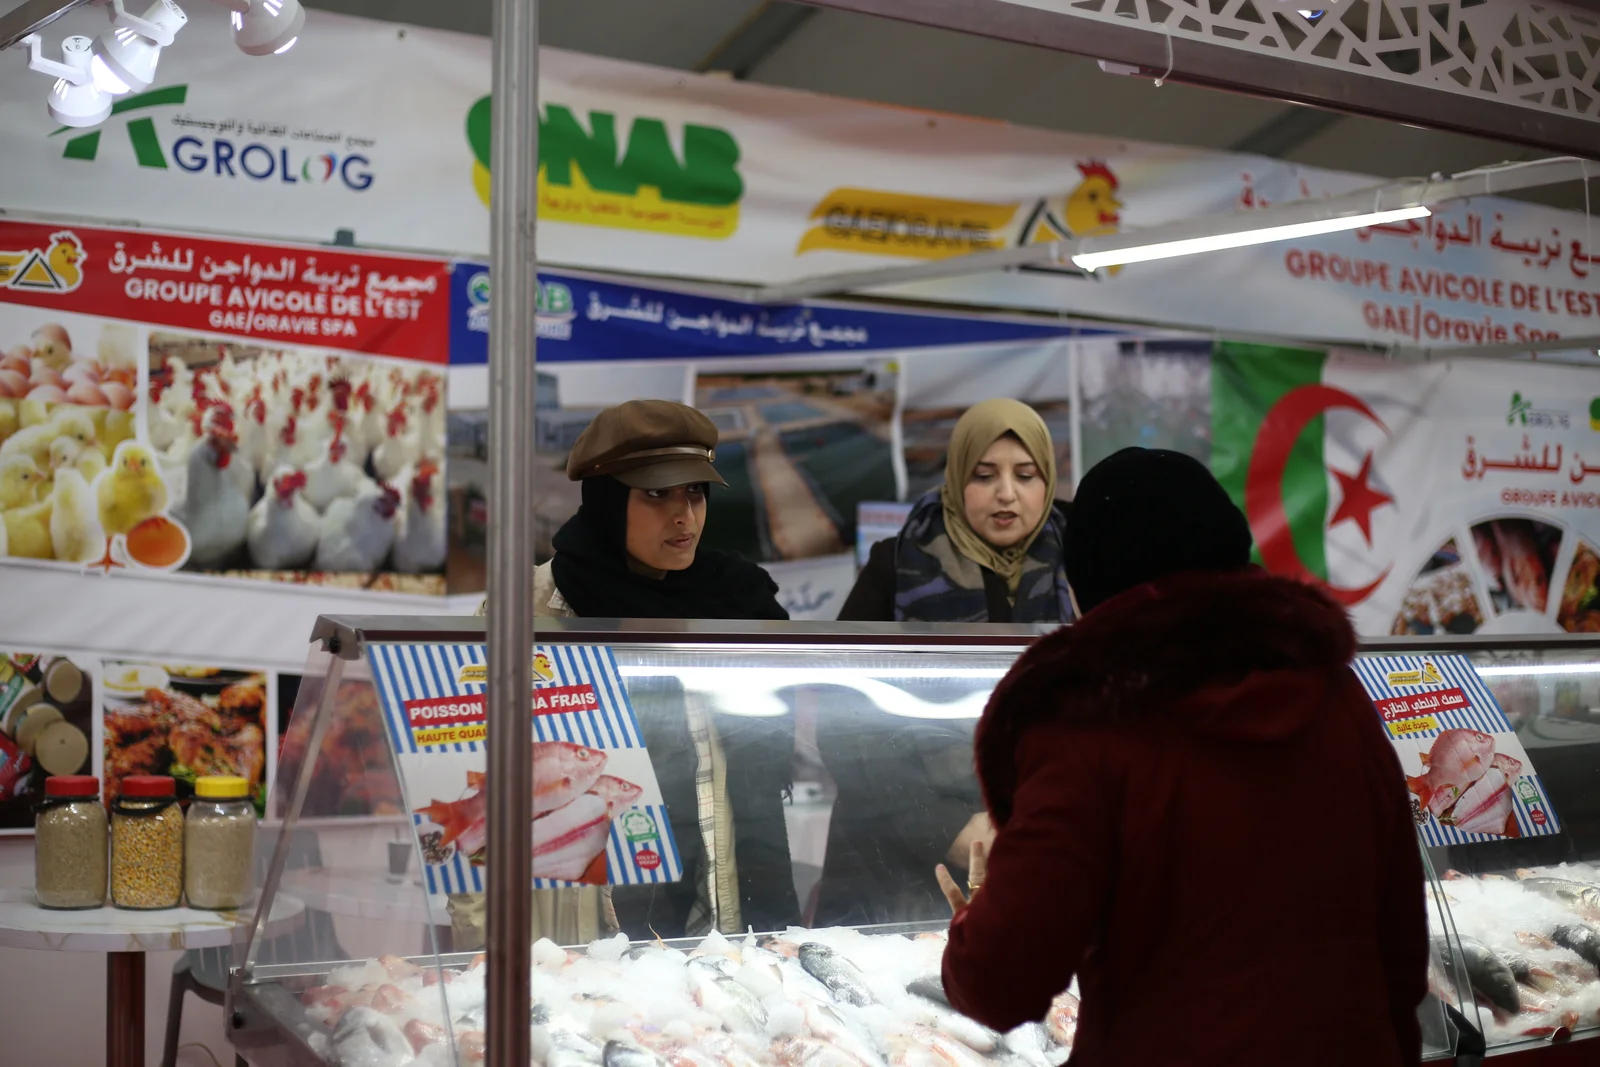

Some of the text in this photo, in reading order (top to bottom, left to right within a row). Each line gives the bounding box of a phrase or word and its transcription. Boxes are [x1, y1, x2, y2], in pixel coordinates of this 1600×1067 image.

[108, 241, 438, 302] مجمع تربية الدواجن للشرق
[1283, 250, 1393, 293] GROUPE
[1398, 265, 1505, 308] AVICOLE
[1509, 282, 1542, 312] DE
[124, 277, 424, 322] GROUPE AVICOLE DE L'EST
[208, 308, 358, 338] GAE/ORAVIE SPA
[1461, 433, 1564, 482] للشرق
[1501, 487, 1559, 508] GROUPE
[410, 702, 483, 721] POISSON
[550, 691, 597, 708] FRAIS
[1382, 694, 1464, 719] سمك البلطي الطازج
[416, 731, 456, 744] HAUTE
[1396, 721, 1430, 734] جودة عالية
